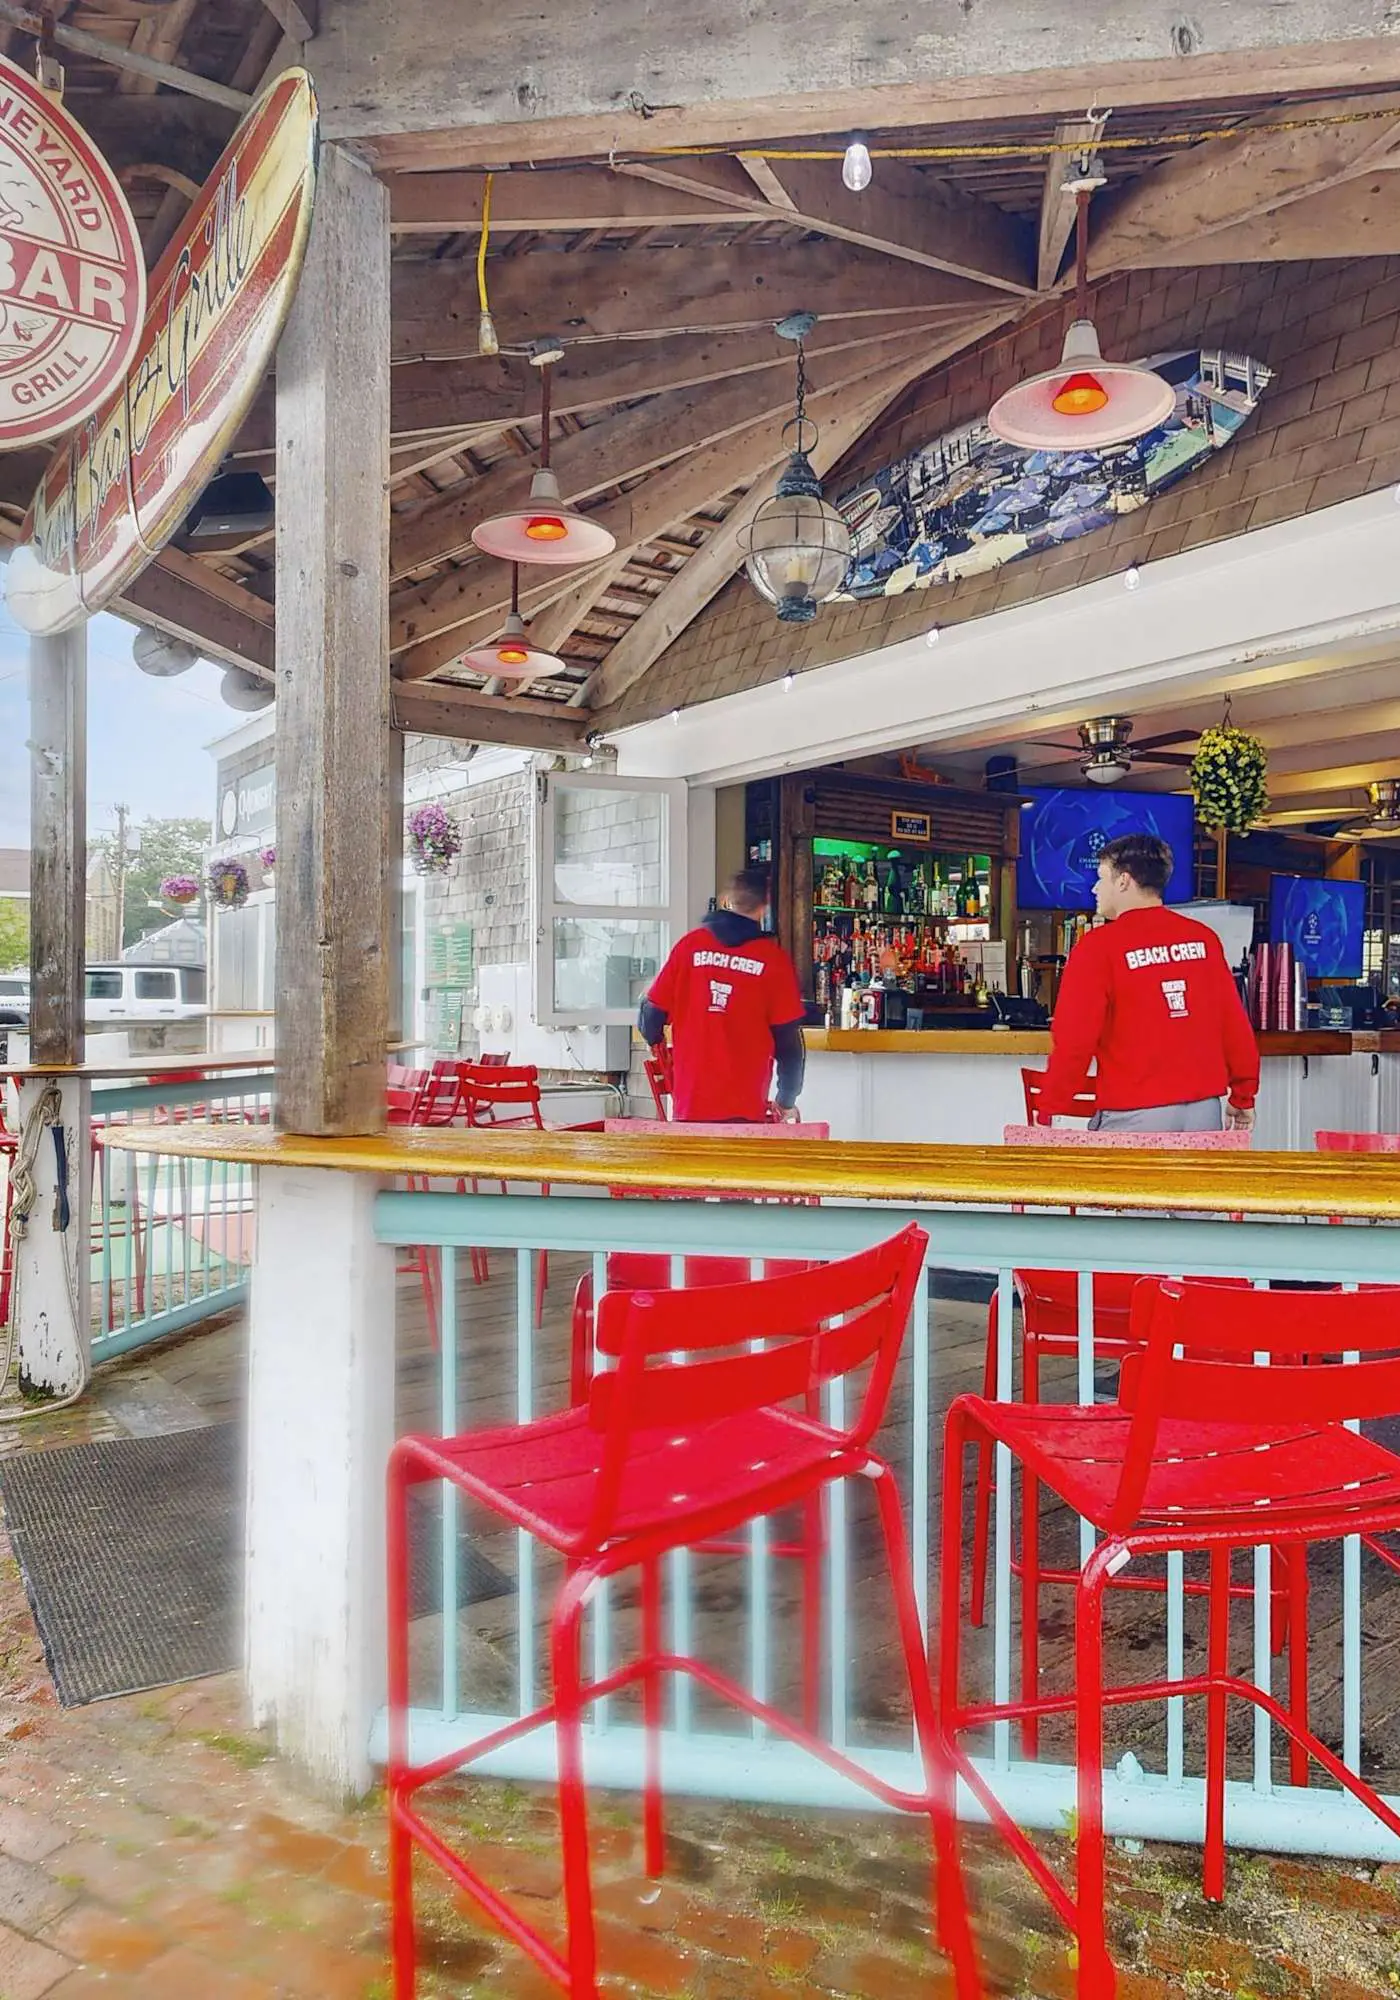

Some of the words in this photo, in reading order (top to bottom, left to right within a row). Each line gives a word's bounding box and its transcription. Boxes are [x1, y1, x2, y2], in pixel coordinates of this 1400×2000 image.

[168, 156, 255, 420] Grille
[11, 351, 89, 405] GRILL
[693, 950, 730, 968] BEACH
[729, 955, 765, 976] CREW
[1125, 945, 1170, 970] BEACH
[1170, 942, 1207, 962] CREW
